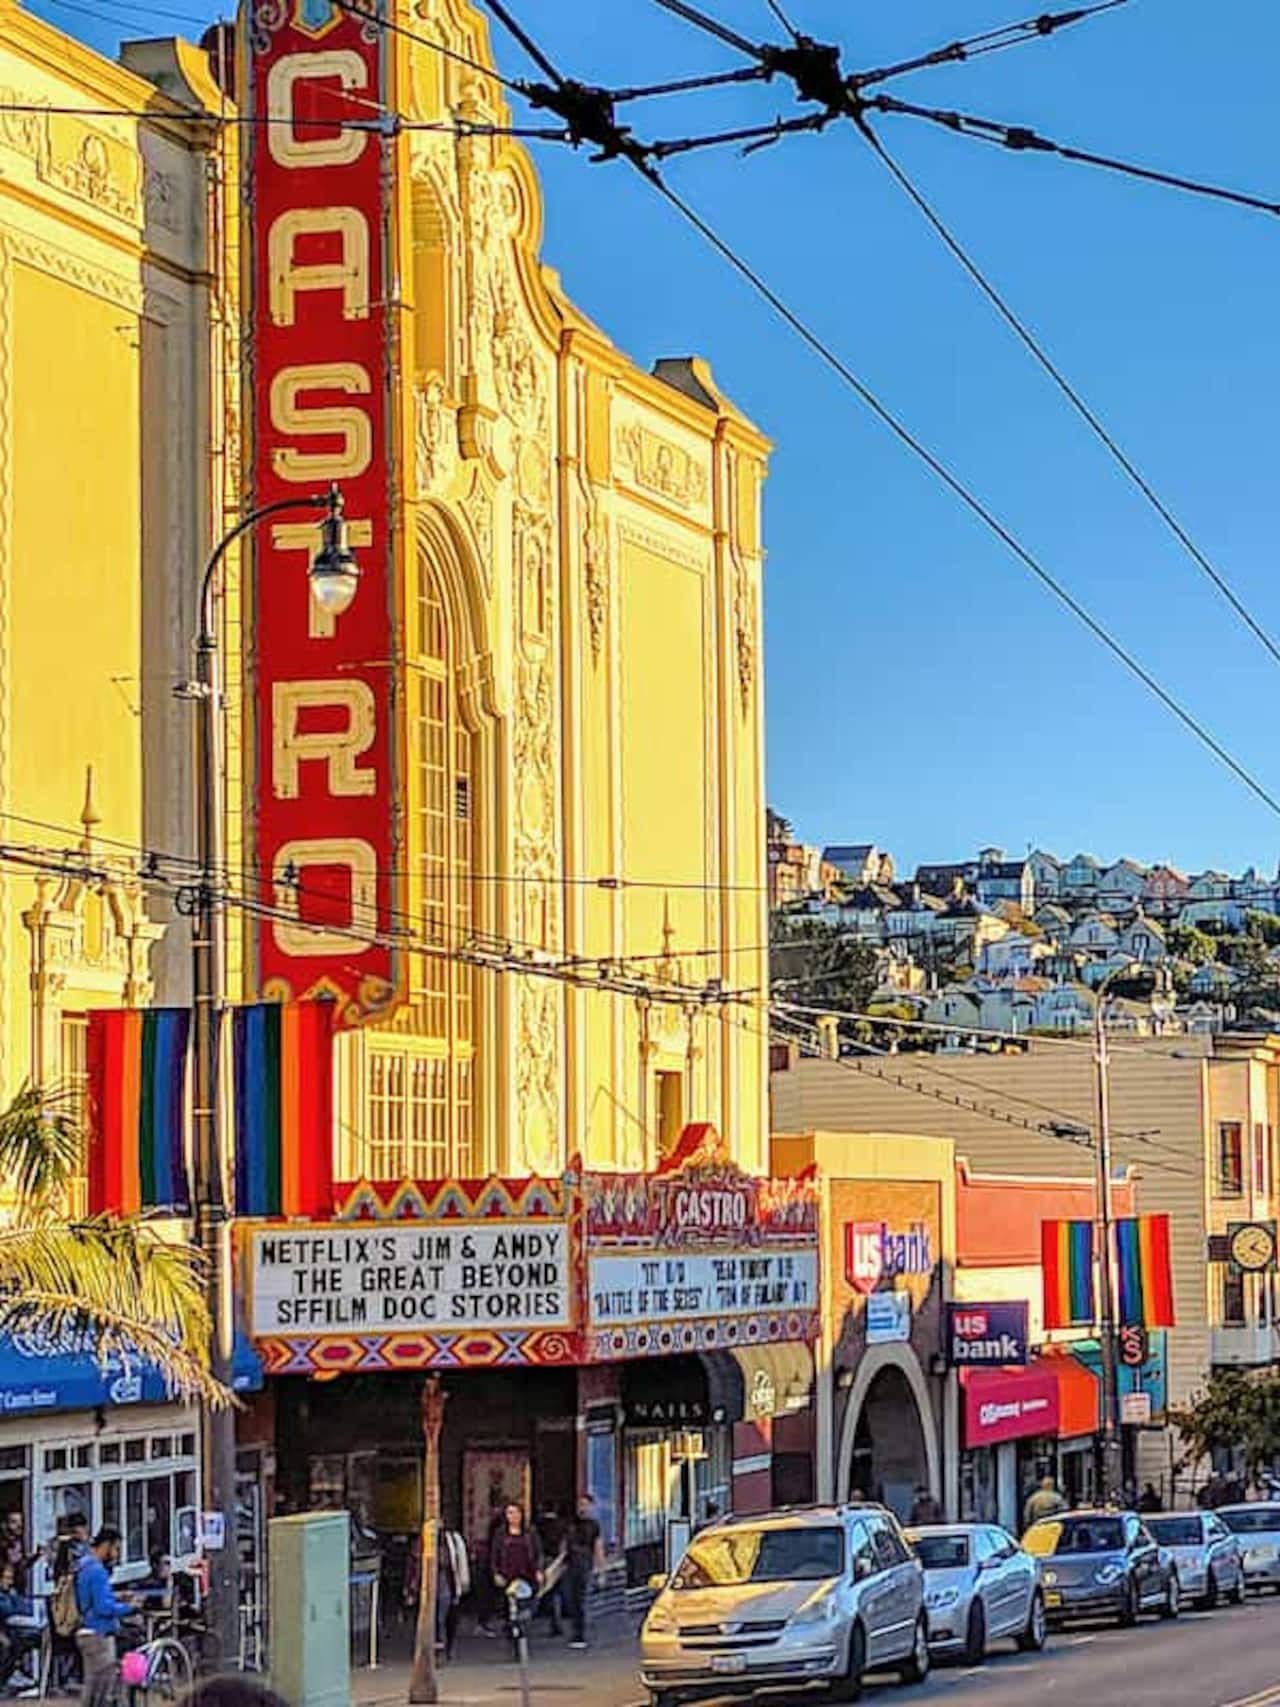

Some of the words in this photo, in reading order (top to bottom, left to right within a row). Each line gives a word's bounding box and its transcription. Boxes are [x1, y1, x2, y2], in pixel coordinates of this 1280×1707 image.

[267, 49, 377, 957] CASTRO
[675, 1191, 746, 1226] CASTRO
[260, 1237, 396, 1265] NETFLIX'S
[412, 1236, 451, 1260] JIM
[461, 1235, 476, 1259] &
[492, 1233, 560, 1258] ANDY
[293, 1268, 342, 1293] THE
[361, 1265, 444, 1291] GREAT
[462, 1262, 558, 1288] BEYOND
[277, 1297, 367, 1323] SFFILM
[383, 1295, 437, 1319] DOC
[451, 1292, 560, 1318] STORIES
[953, 1334, 1018, 1359] bank
[635, 1403, 702, 1419] NAILS
